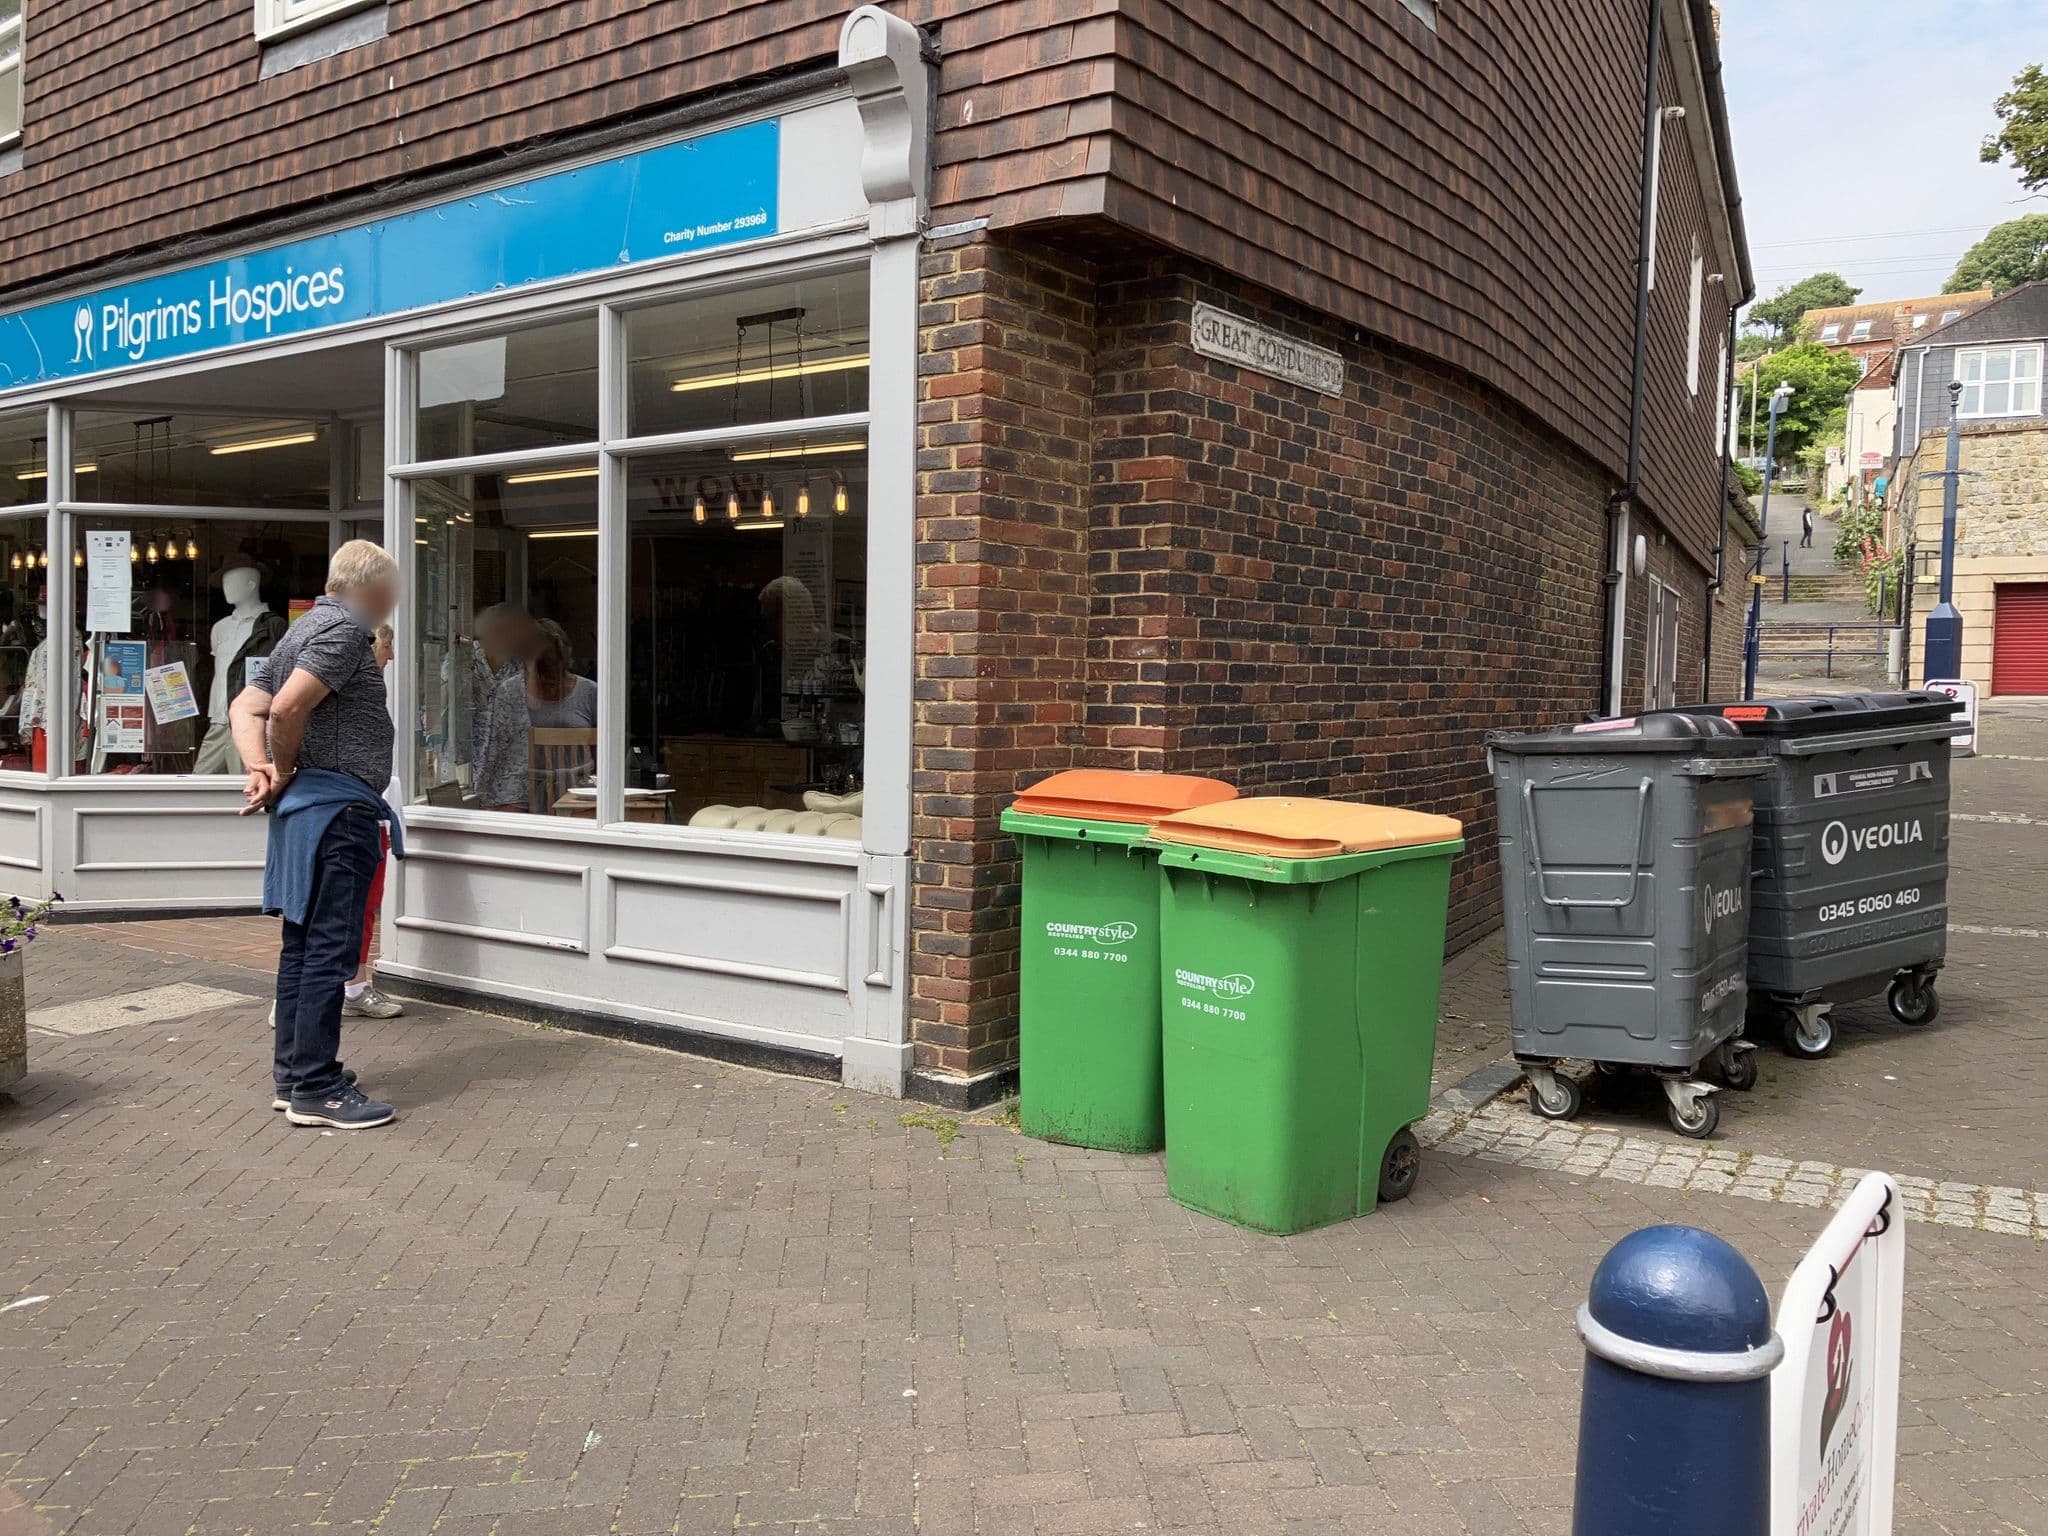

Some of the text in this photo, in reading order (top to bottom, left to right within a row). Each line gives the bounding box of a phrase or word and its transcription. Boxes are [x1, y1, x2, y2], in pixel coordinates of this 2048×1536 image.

[663, 213, 767, 243] Charity Number 293968
[102, 266, 345, 360] Pilgrims Hospices
[1201, 319, 1251, 354] GREAT
[1852, 820, 1923, 852] VEOLIA
[1712, 886, 1743, 920] VEOLIA
[1819, 888, 1920, 922] 0345 6060 460
[1054, 947, 1128, 963] 0344 880 7700
[1181, 997, 1246, 1021] 0344 880 7700
